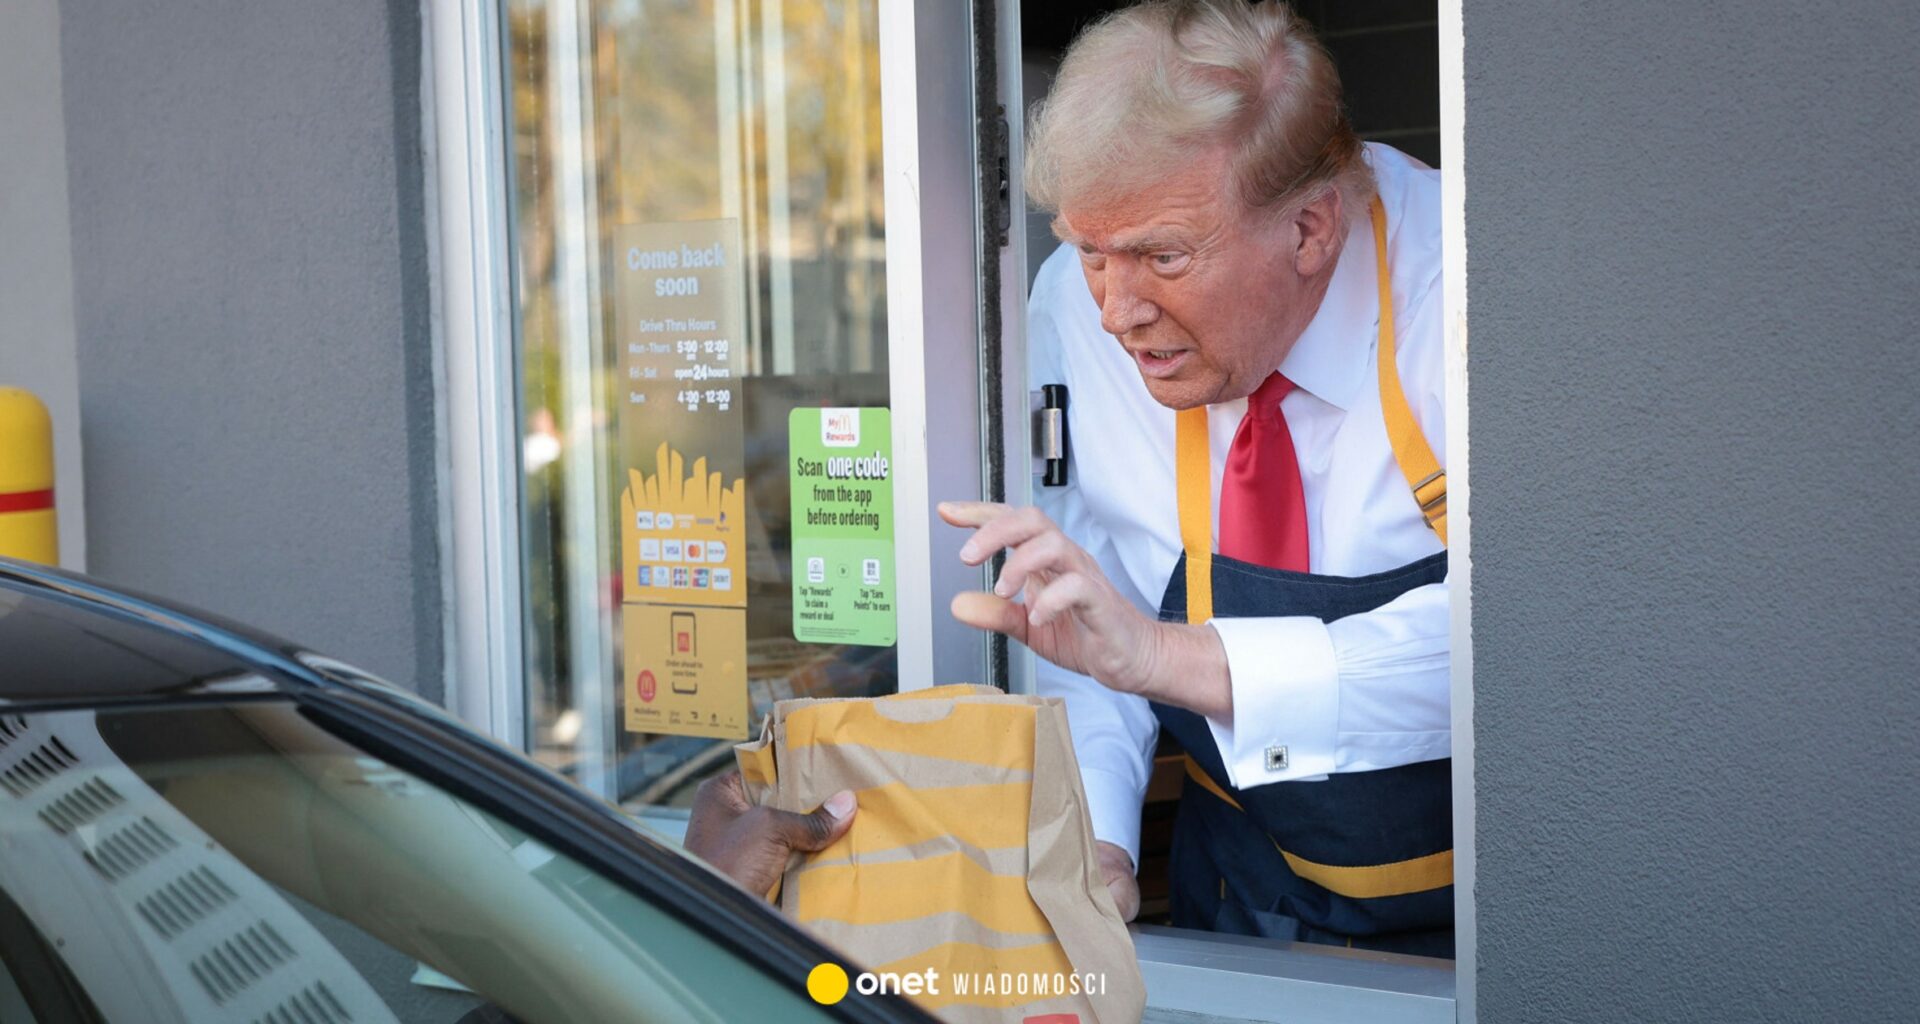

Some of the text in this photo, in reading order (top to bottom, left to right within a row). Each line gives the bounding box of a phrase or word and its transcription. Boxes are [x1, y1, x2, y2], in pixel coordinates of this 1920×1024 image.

[627, 243, 725, 271] Come back
[655, 275, 698, 297] soon
[640, 318, 717, 332] Drive Thru Hours
[828, 418, 838, 430] My
[826, 432, 856, 442] Rewards
[797, 450, 889, 481] Scan one code
[813, 484, 873, 507] from the app
[806, 507, 880, 531] before ordering
[665, 546, 680, 555] VISA
